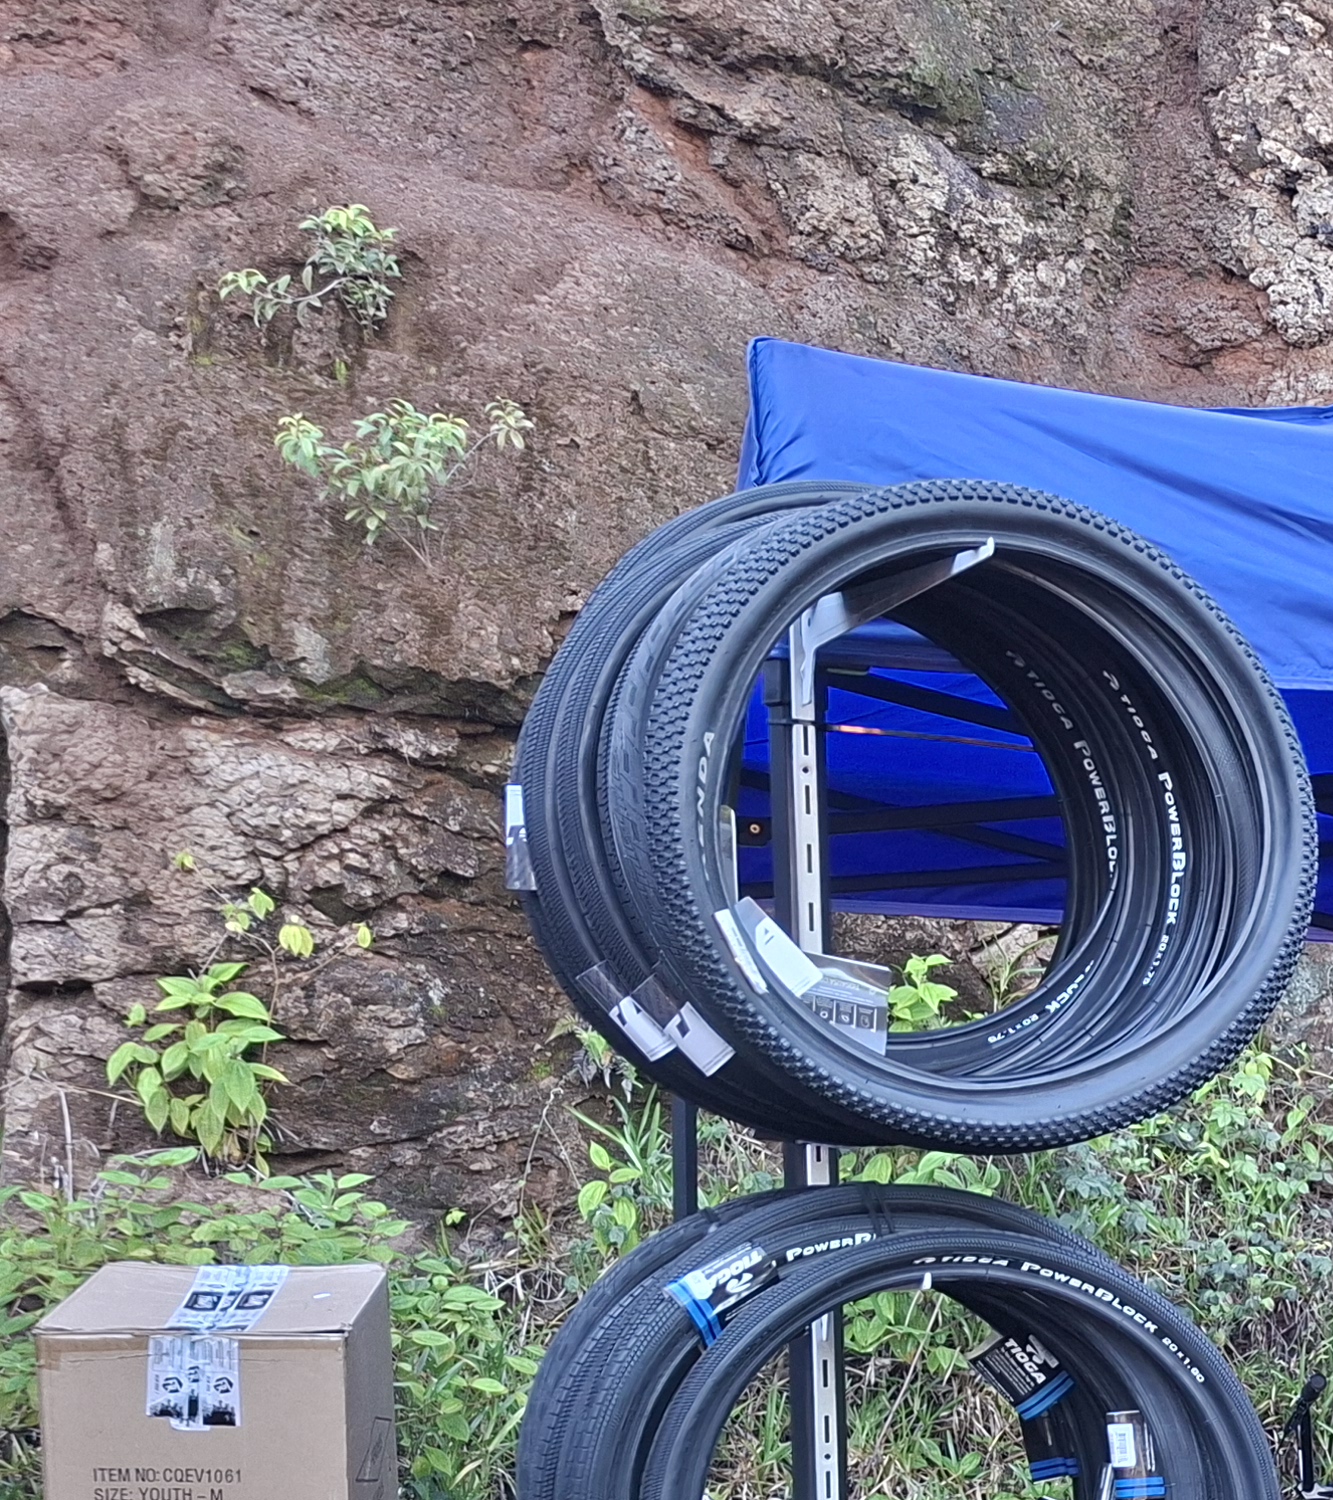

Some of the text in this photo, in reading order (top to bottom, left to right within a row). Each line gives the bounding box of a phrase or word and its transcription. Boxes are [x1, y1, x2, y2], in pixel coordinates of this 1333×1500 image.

[1004, 1338, 1047, 1384] TIOGA
[93, 1468, 242, 1483] ITEM NO: CQEV1061
